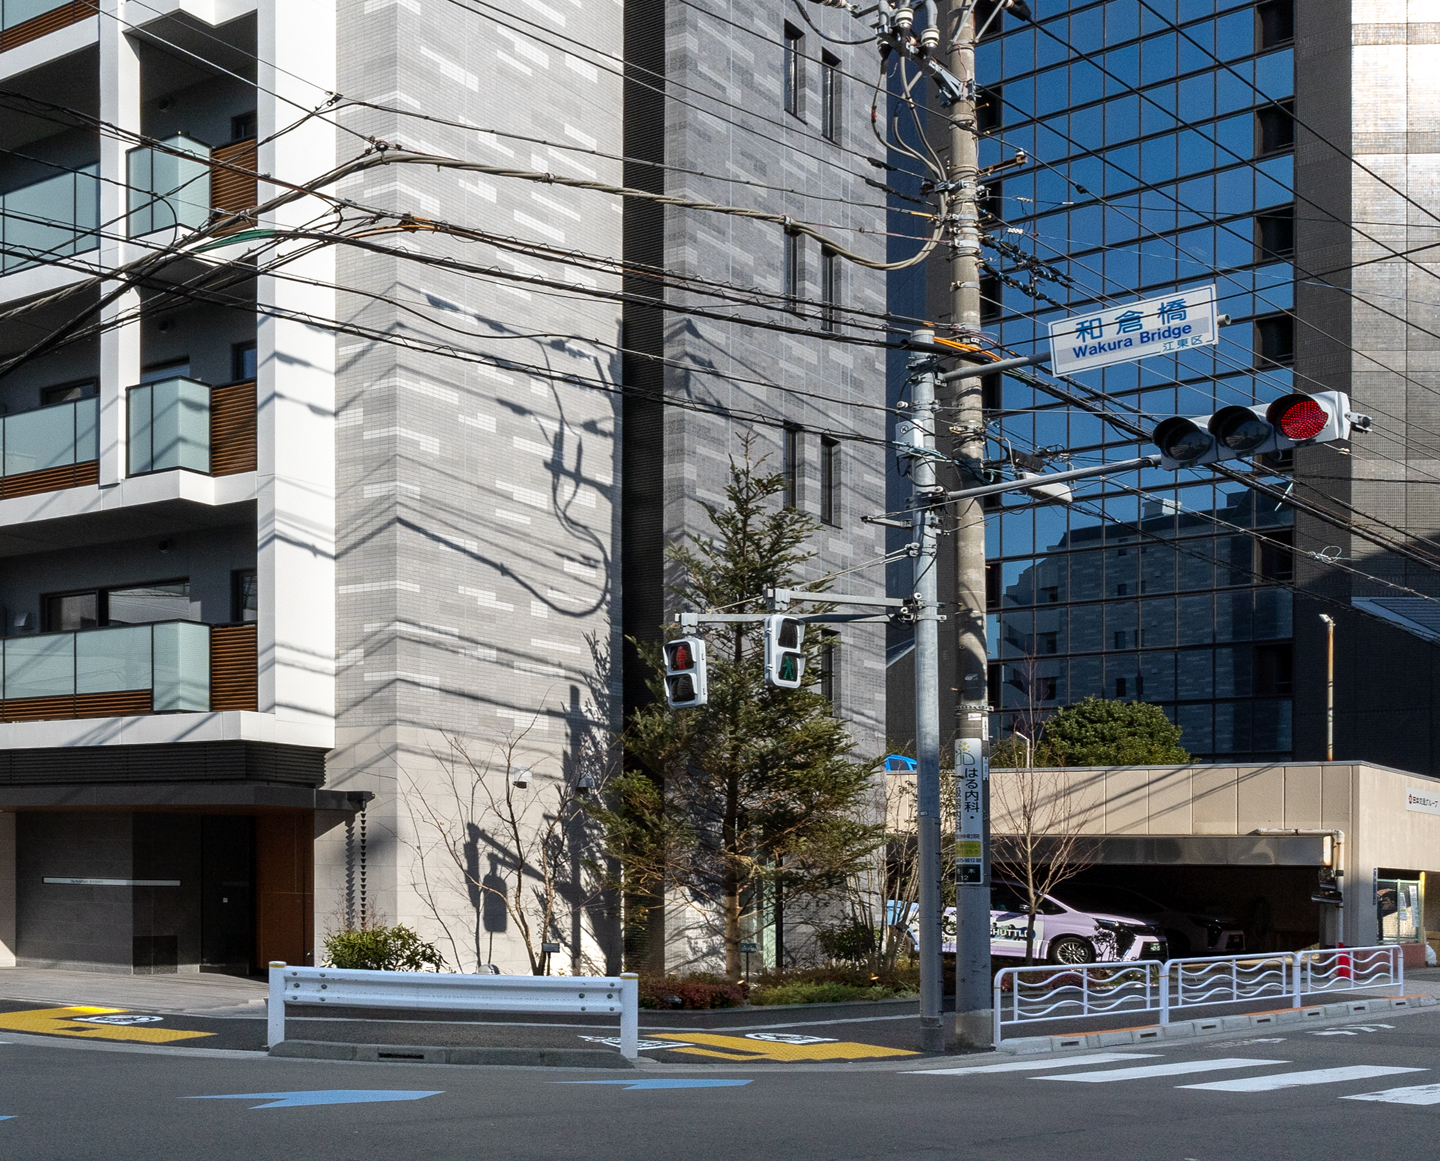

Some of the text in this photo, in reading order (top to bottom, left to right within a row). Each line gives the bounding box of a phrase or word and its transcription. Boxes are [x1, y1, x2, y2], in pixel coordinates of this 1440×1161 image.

[1075, 298, 1187, 343] 和倉橋
[1073, 324, 1192, 359] Wakura Bridge
[1162, 334, 1204, 353] 江東区
